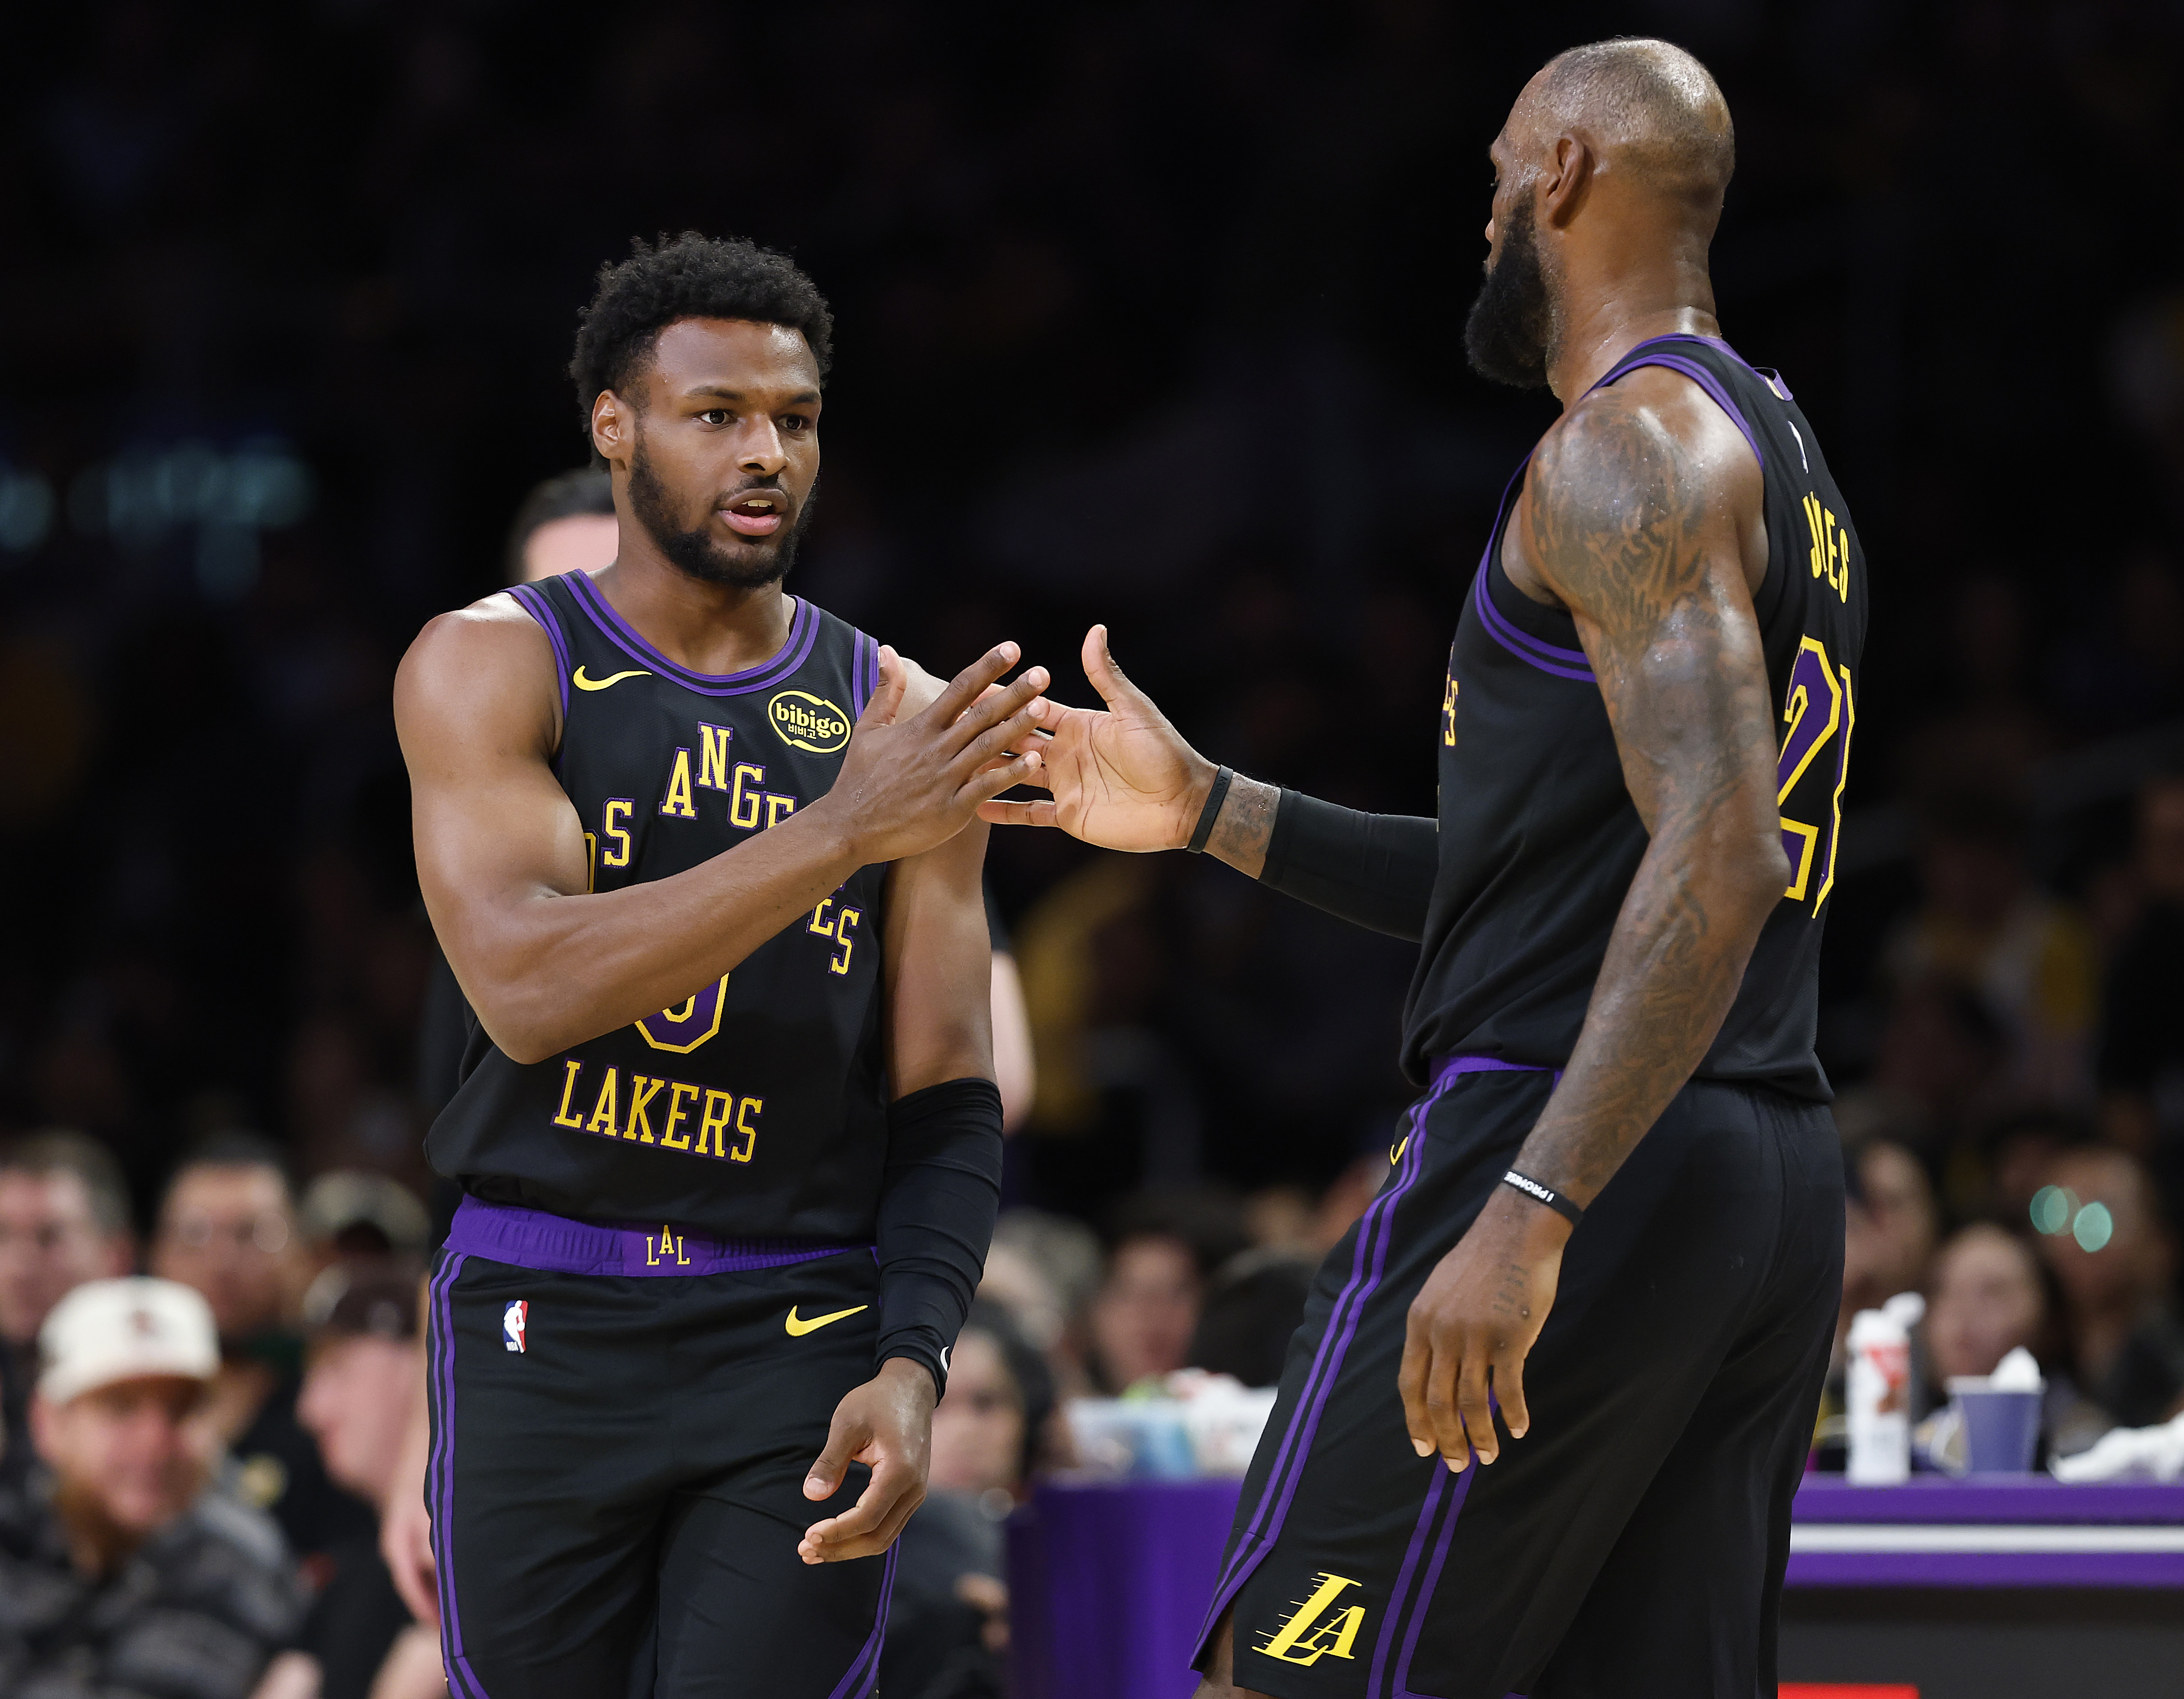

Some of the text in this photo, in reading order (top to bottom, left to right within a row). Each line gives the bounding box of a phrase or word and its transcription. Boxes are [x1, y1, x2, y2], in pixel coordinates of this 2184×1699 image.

[775, 702, 845, 739] bibigo
[788, 723, 817, 740] 비비고
[551, 1057, 765, 1166] LAKERS
[646, 1224, 690, 1265] LAL
[506, 1341, 519, 1352] NBA
[1252, 1572, 1366, 1667] LA
